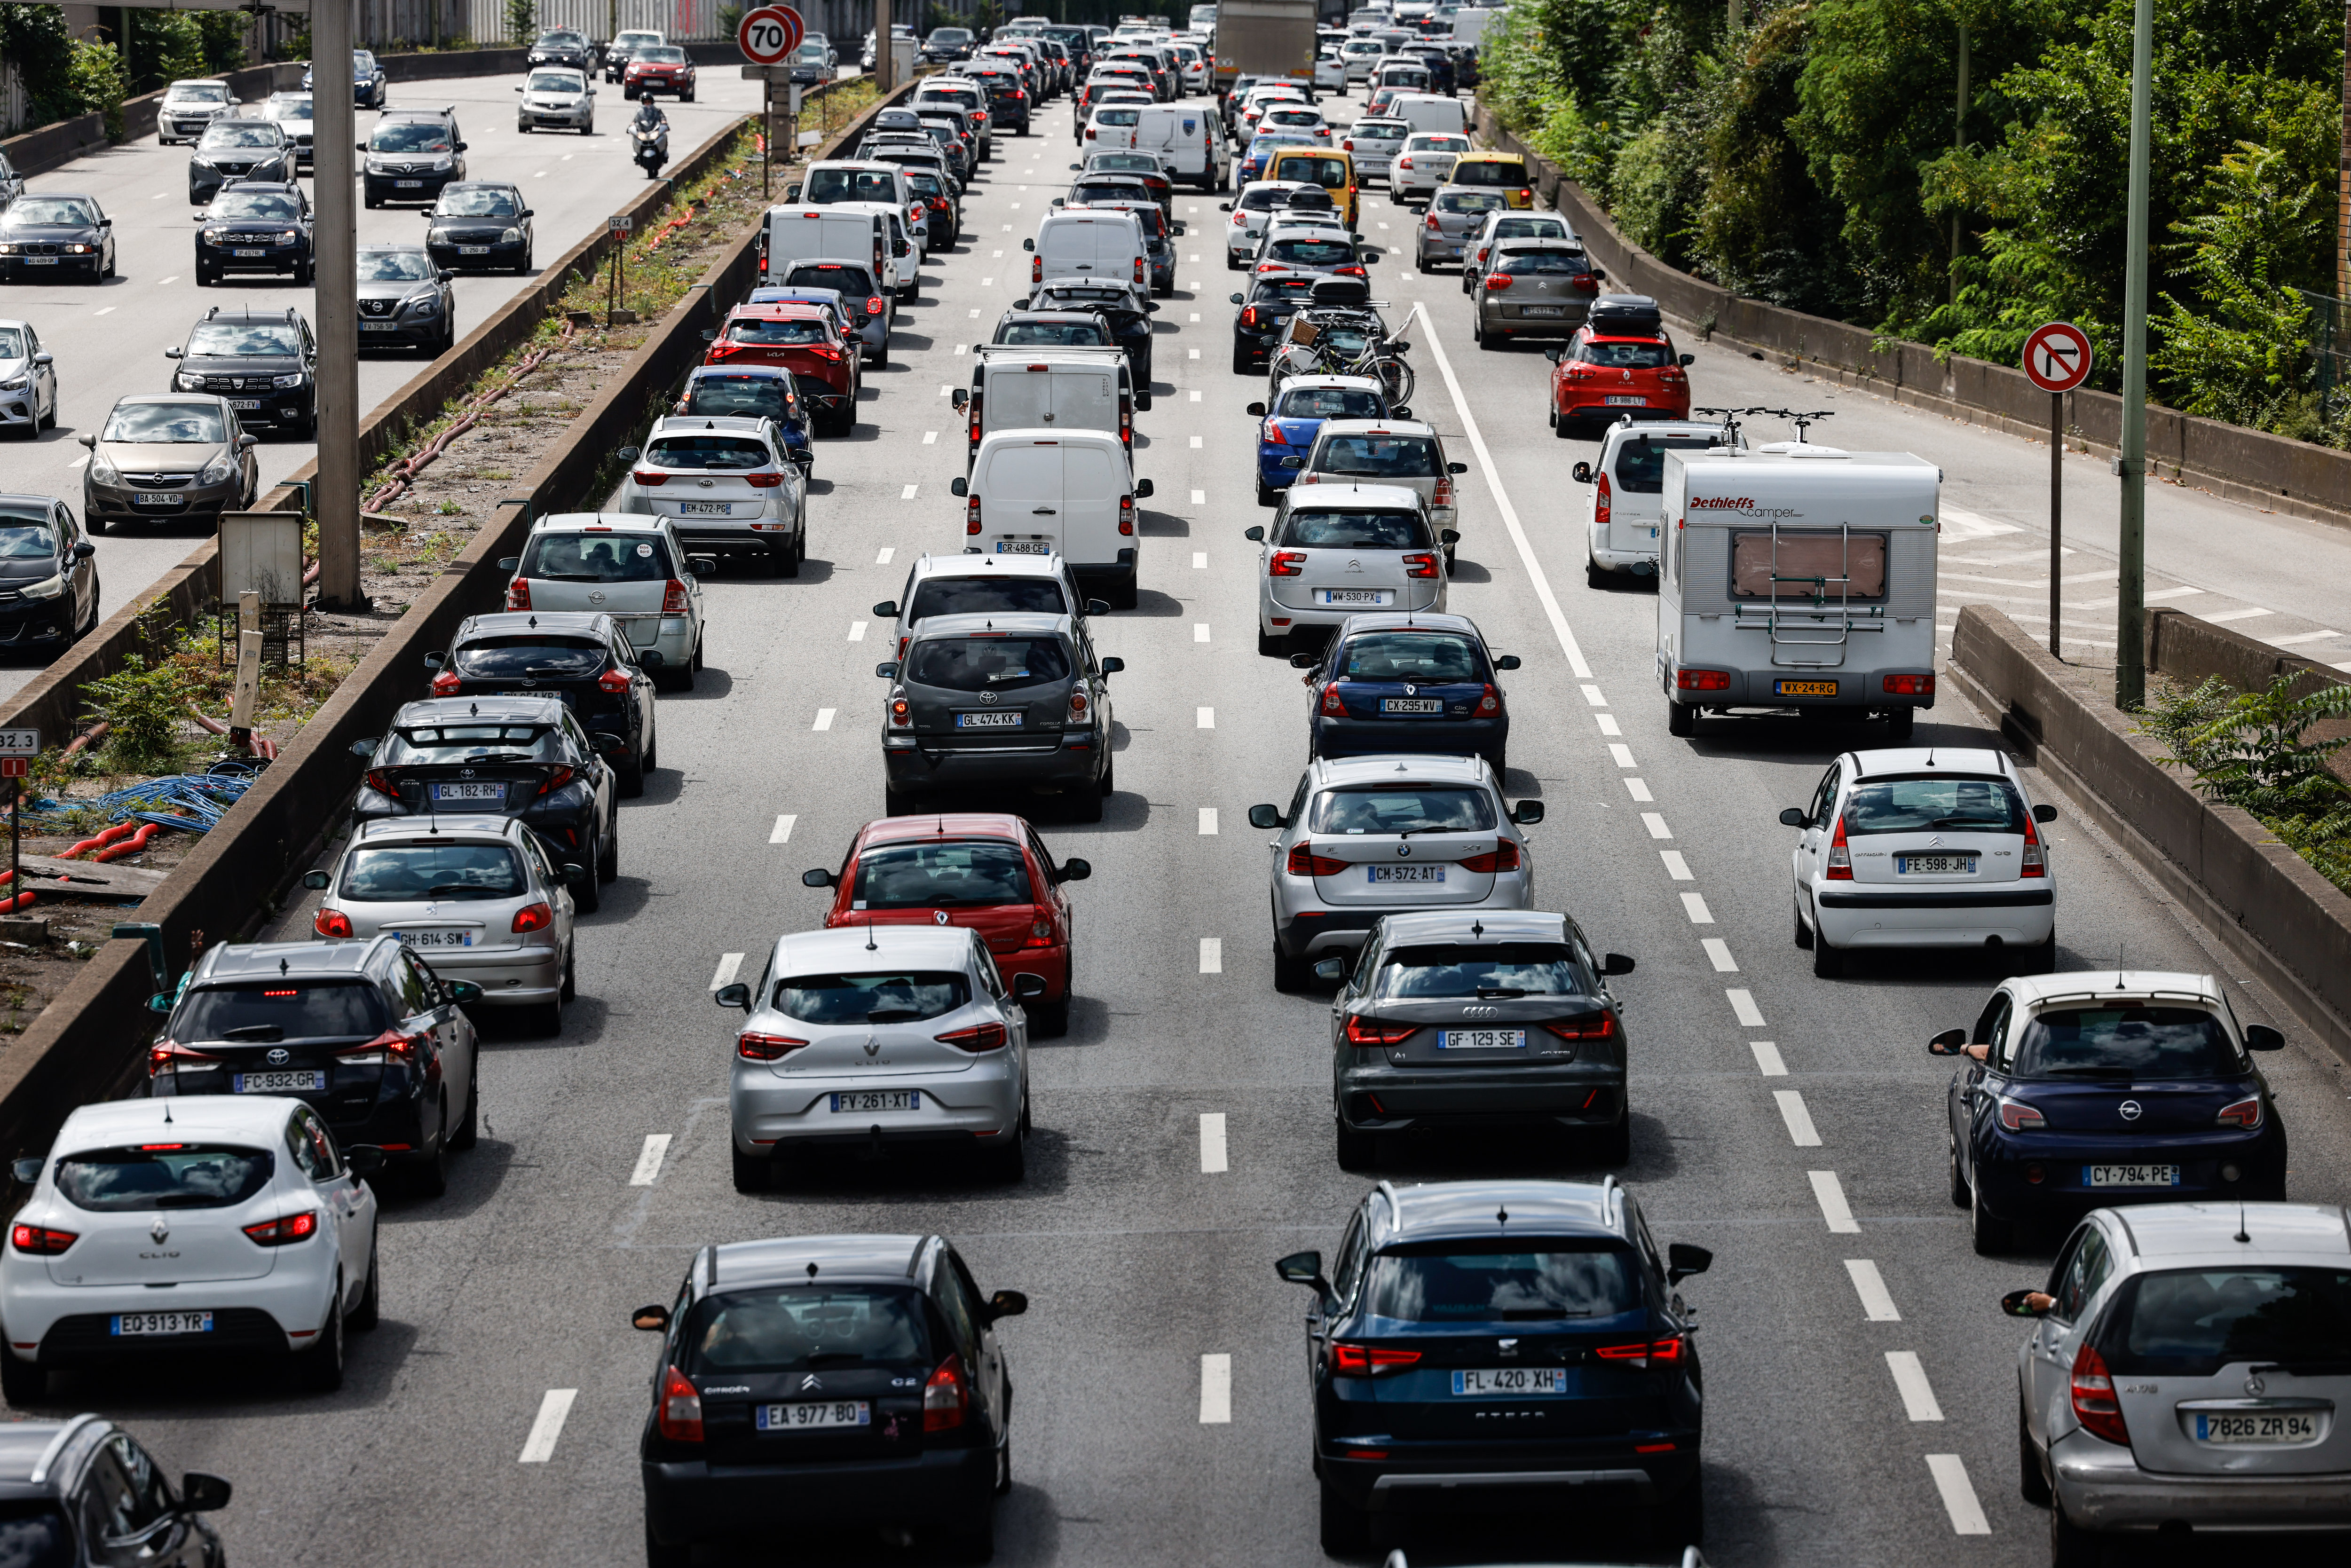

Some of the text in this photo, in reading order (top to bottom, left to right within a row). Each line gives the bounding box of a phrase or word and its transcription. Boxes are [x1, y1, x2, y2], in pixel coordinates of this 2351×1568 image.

[752, 26, 782, 47] 70
[233, 400, 255, 408] 672-FV
[140, 494, 178, 503] BA-504-VD
[1690, 496, 1754, 508] Dethleffs
[687, 504, 726, 513] EM-472-PG
[1747, 509, 1793, 519] camper
[1002, 544, 1043, 552] CR-488-CE
[1333, 591, 1374, 600] WW-530-PX
[1785, 683, 1833, 693] WX-24-RG
[1387, 700, 1435, 711] CX-295-WV
[964, 713, 1015, 725] GL-474-KK
[0, 735, 33, 748] 32.3
[441, 785, 496, 797] GL-182-RH
[1907, 858, 1966, 871] FE-598-JH
[1376, 867, 1436, 881] CM-572-AT
[400, 932, 463, 945] GH-614-SW
[1447, 1032, 1515, 1046] GF-129-SE
[243, 1070, 315, 1089] FC-932-GR
[840, 1093, 910, 1109] FV-261-XT
[2094, 1167, 2170, 1182] CY-794-PE
[121, 1314, 202, 1332] EQ-913-YR
[891, 1378, 916, 1386] C2
[1464, 1370, 1554, 1390] FL-420-XH
[770, 1403, 856, 1425] EA-977-BQ
[2209, 1415, 2312, 1435] 7826 ZR 94
